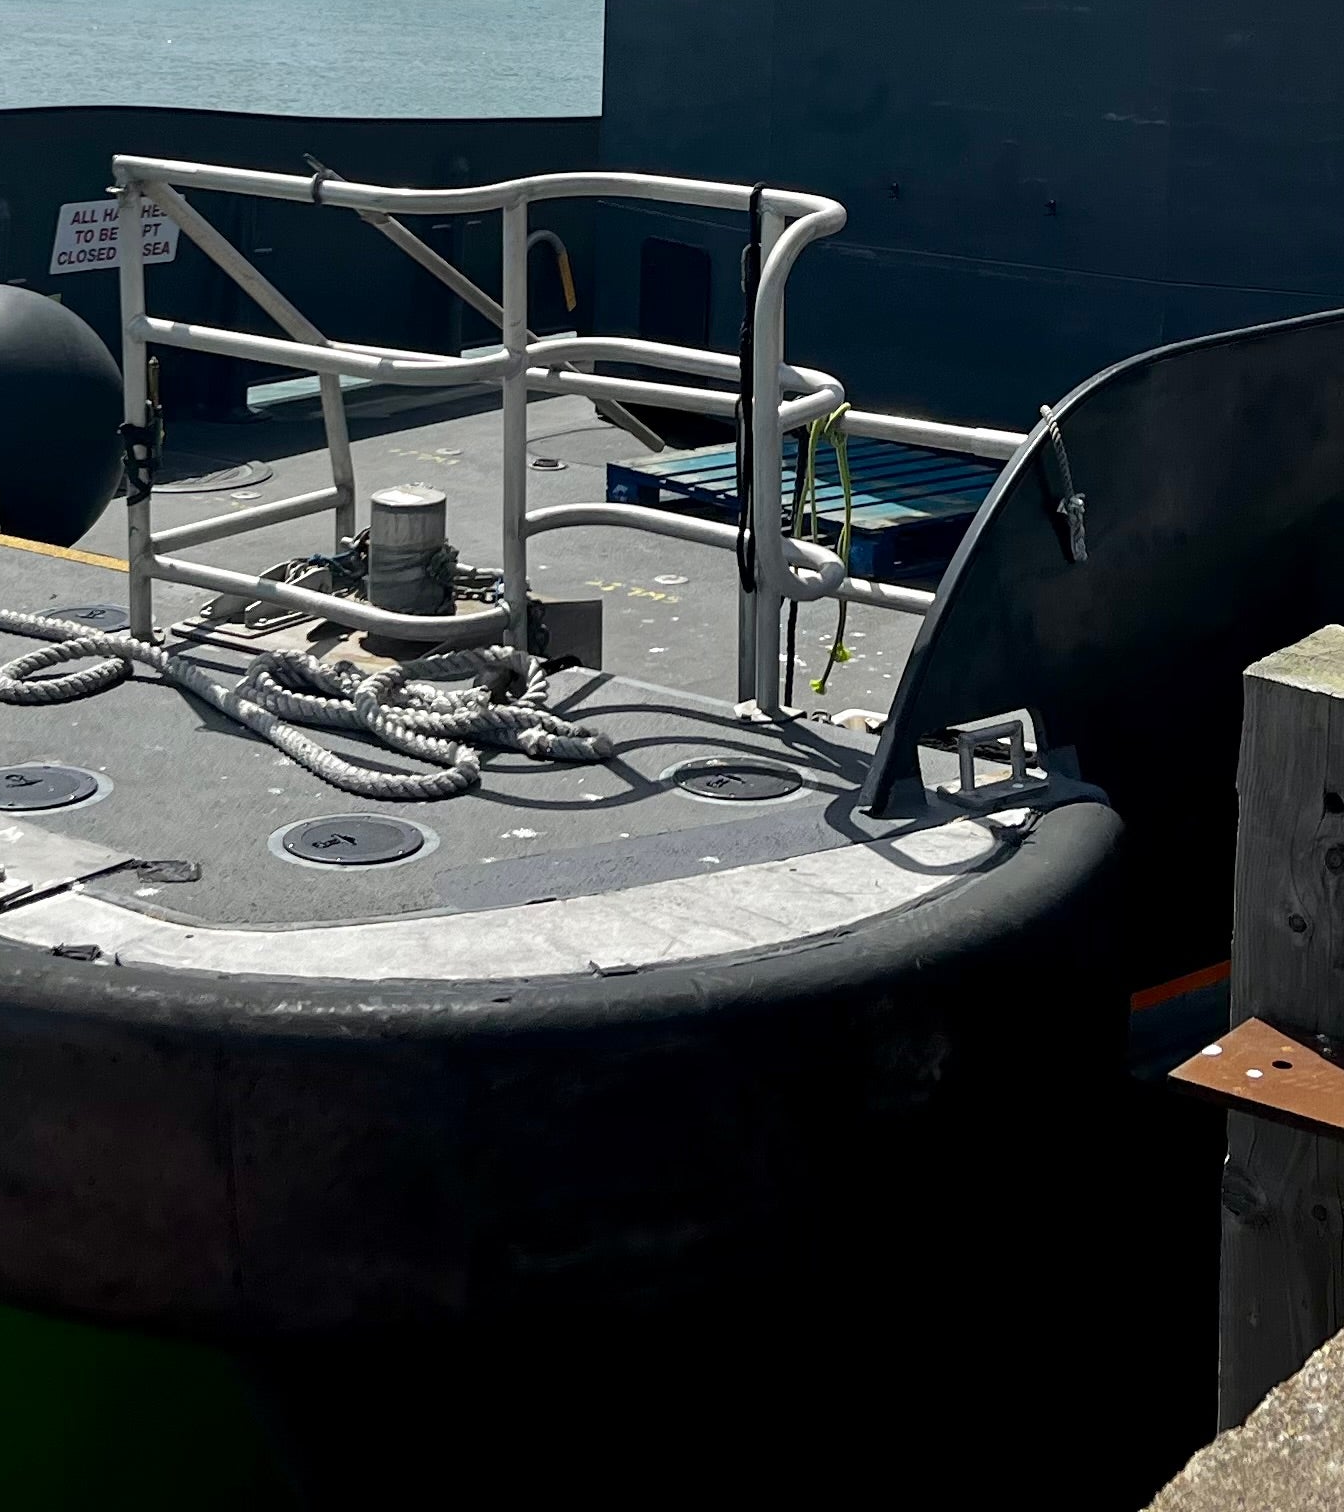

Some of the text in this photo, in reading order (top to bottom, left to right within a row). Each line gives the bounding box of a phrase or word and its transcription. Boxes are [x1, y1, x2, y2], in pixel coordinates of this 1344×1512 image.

[70, 209, 99, 225] ALL
[75, 229, 94, 244] TO
[99, 227, 119, 241] BE
[57, 241, 170, 265] CLOSED SEA
